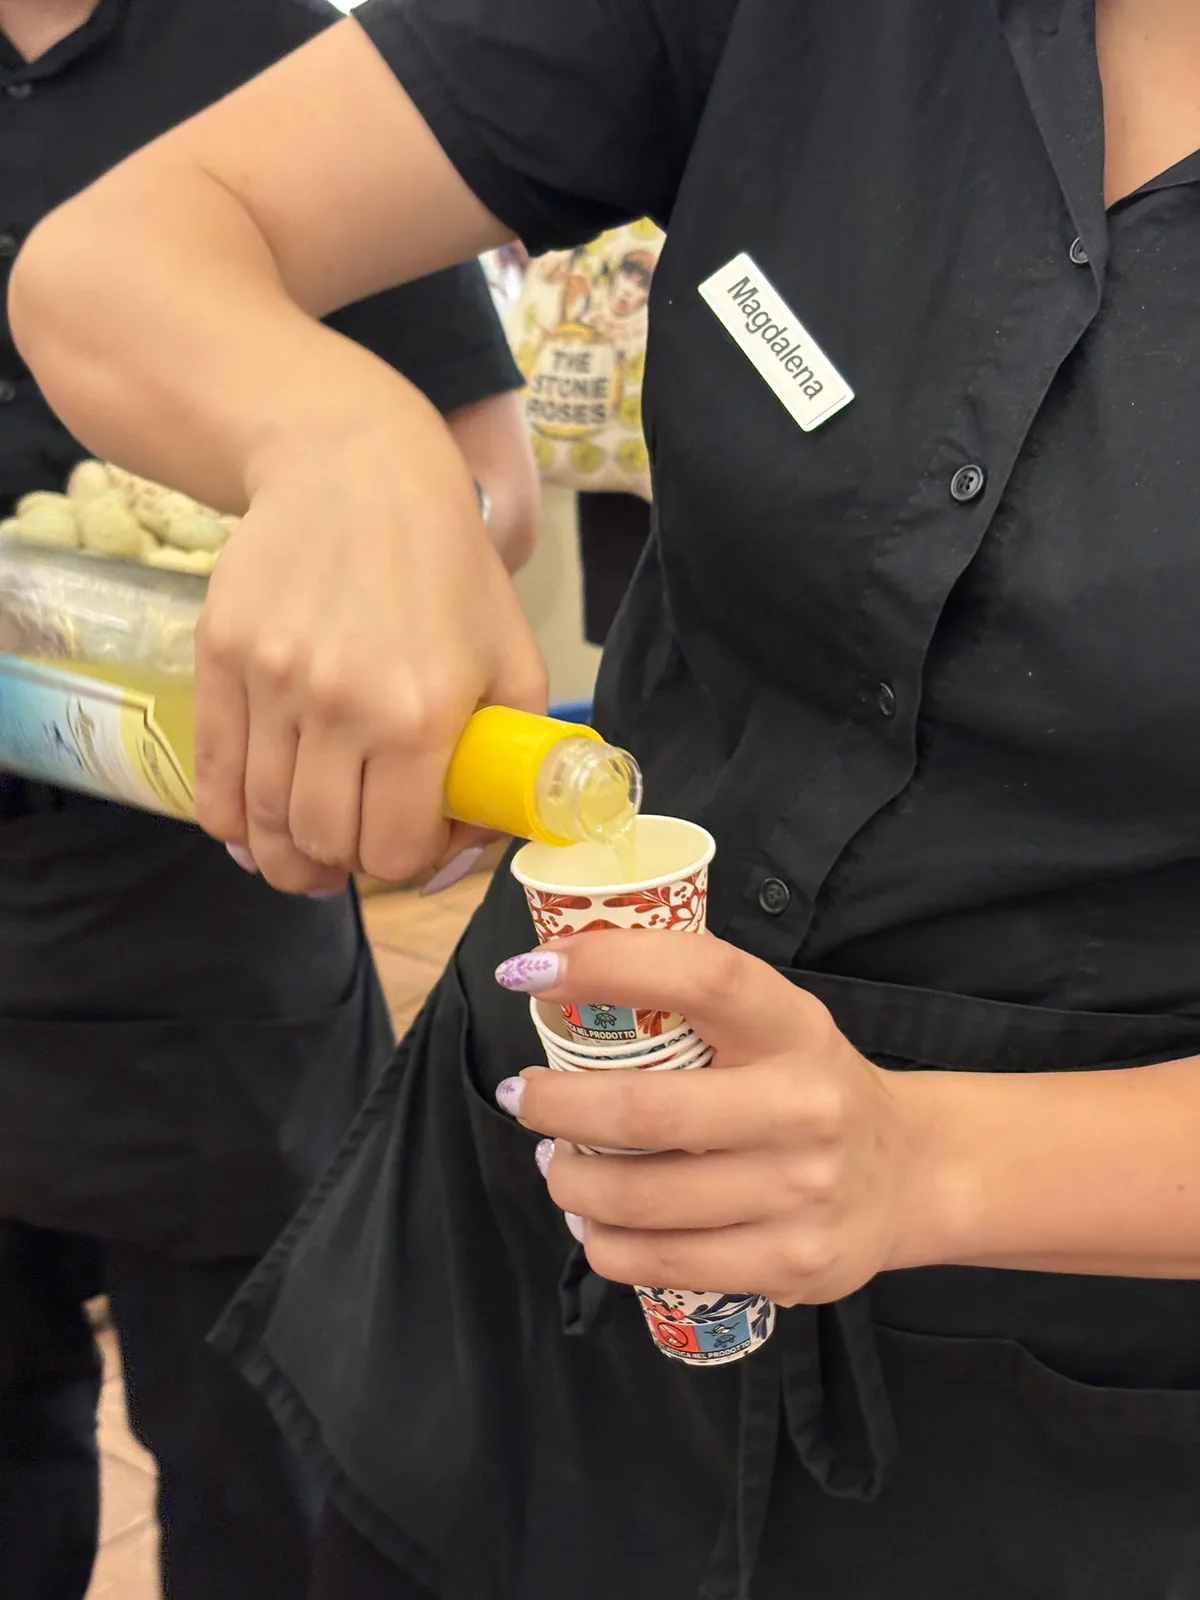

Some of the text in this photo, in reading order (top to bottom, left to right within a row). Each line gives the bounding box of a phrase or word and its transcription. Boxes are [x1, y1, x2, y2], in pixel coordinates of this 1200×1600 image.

[727, 276, 824, 401] Magdalena
[553, 350, 591, 373] THE
[533, 375, 608, 399] STONE
[577, 1026, 636, 1040] NEL PRODOTTO
[708, 1340, 750, 1358] PRODOTTO
